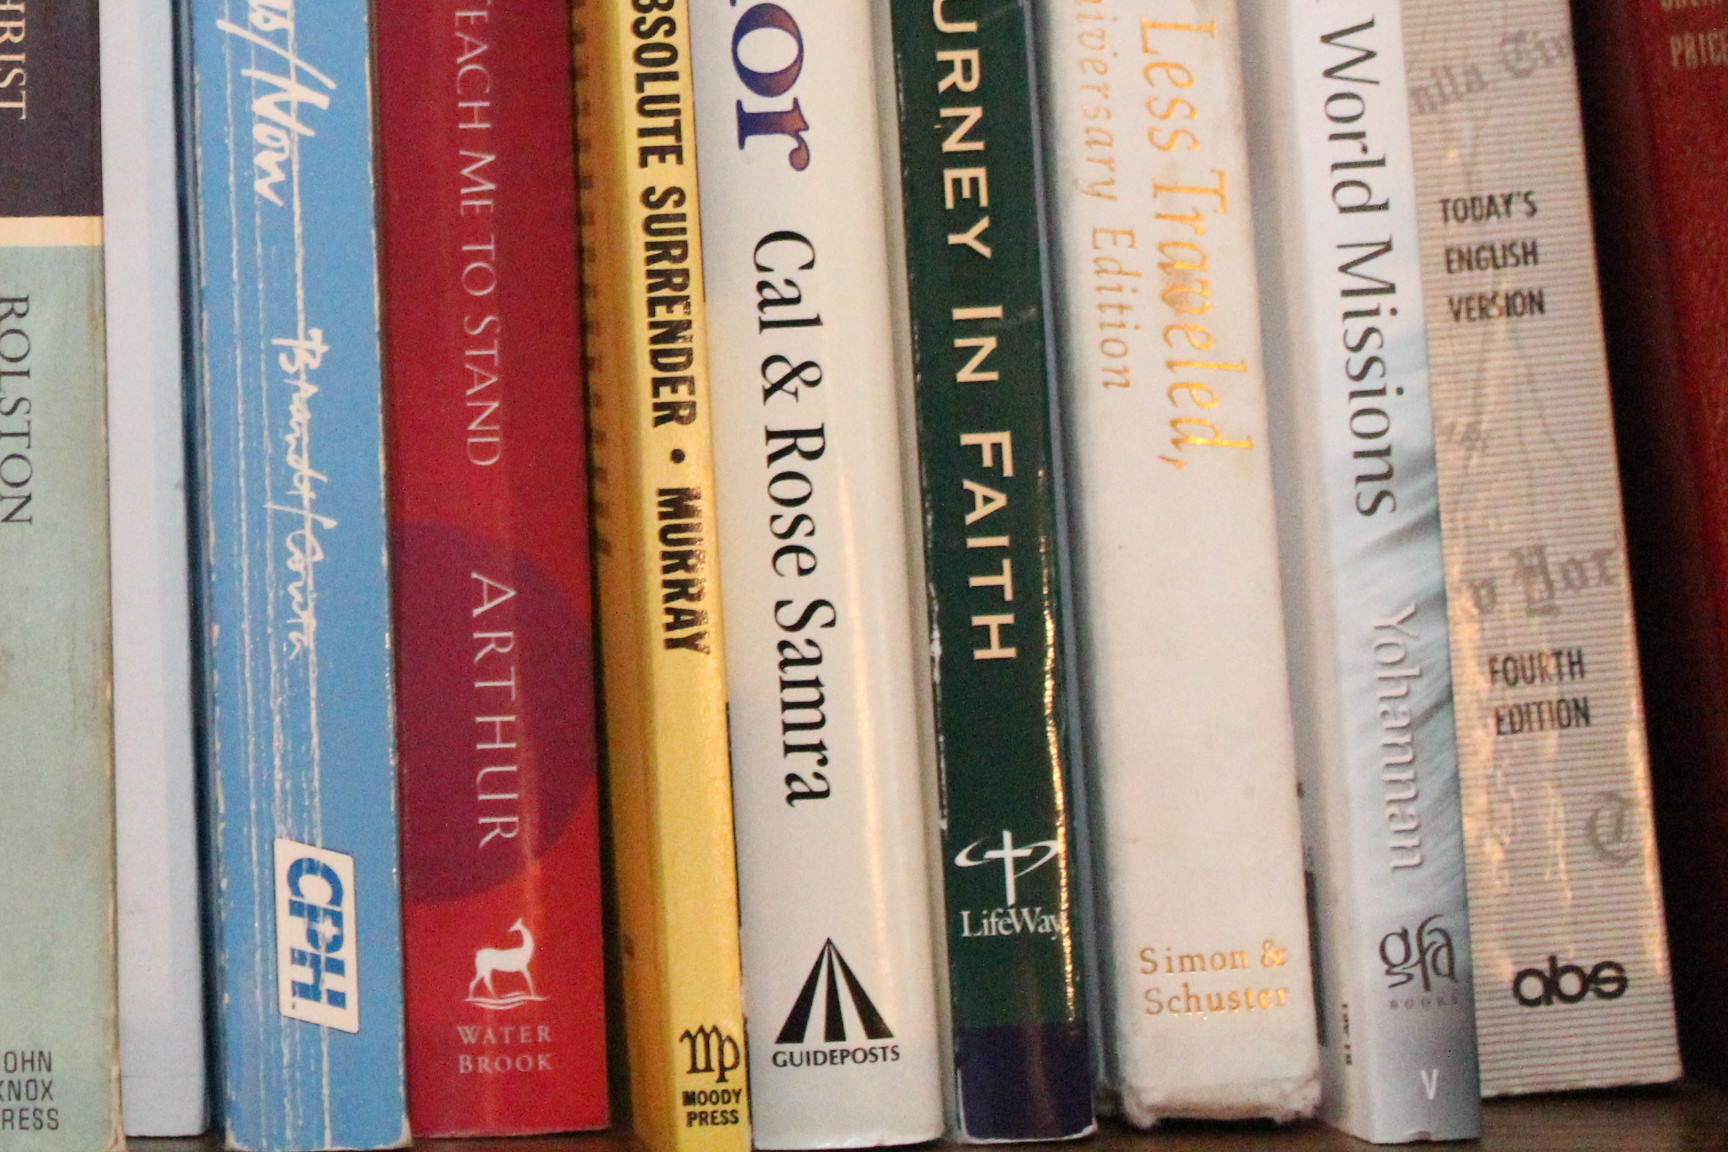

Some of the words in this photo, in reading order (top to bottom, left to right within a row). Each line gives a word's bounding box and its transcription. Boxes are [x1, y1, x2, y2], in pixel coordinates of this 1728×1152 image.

[1140, 17, 1217, 153] Less
[1319, 14, 1390, 215] World
[458, 149, 497, 215] ME
[1440, 191, 1537, 223] TODAY'S
[461, 244, 497, 297] TO
[753, 230, 824, 335] Cal
[1446, 241, 1538, 273] ENGLISH
[640, 185, 697, 428] SURRENDER
[1090, 226, 1141, 390] Edition
[1447, 290, 1545, 323] VERSION
[952, 306, 1002, 382] IN
[463, 315, 501, 467] STAND
[762, 354, 824, 403] &
[1336, 235, 1405, 518] Missions
[765, 422, 825, 578] Rose
[657, 486, 709, 654] MURRAY
[959, 430, 1016, 661] FAITH
[1488, 650, 1585, 687] FOURTH
[471, 572, 520, 848] ARTHUR
[776, 601, 836, 807] Samra
[1496, 697, 1591, 736] EDITION
[1373, 604, 1424, 875] Yohannan
[962, 905, 1061, 944] LifeWay
[1139, 946, 1249, 977] Simon
[1261, 940, 1288, 967] &
[1145, 981, 1288, 1018] Schuster
[457, 1024, 551, 1046] WATER
[458, 1053, 552, 1074] BROOK
[772, 1045, 899, 1069] GUIDEPOSTS
[682, 1089, 741, 1108] MOODY
[686, 1107, 739, 1126] PRESS
